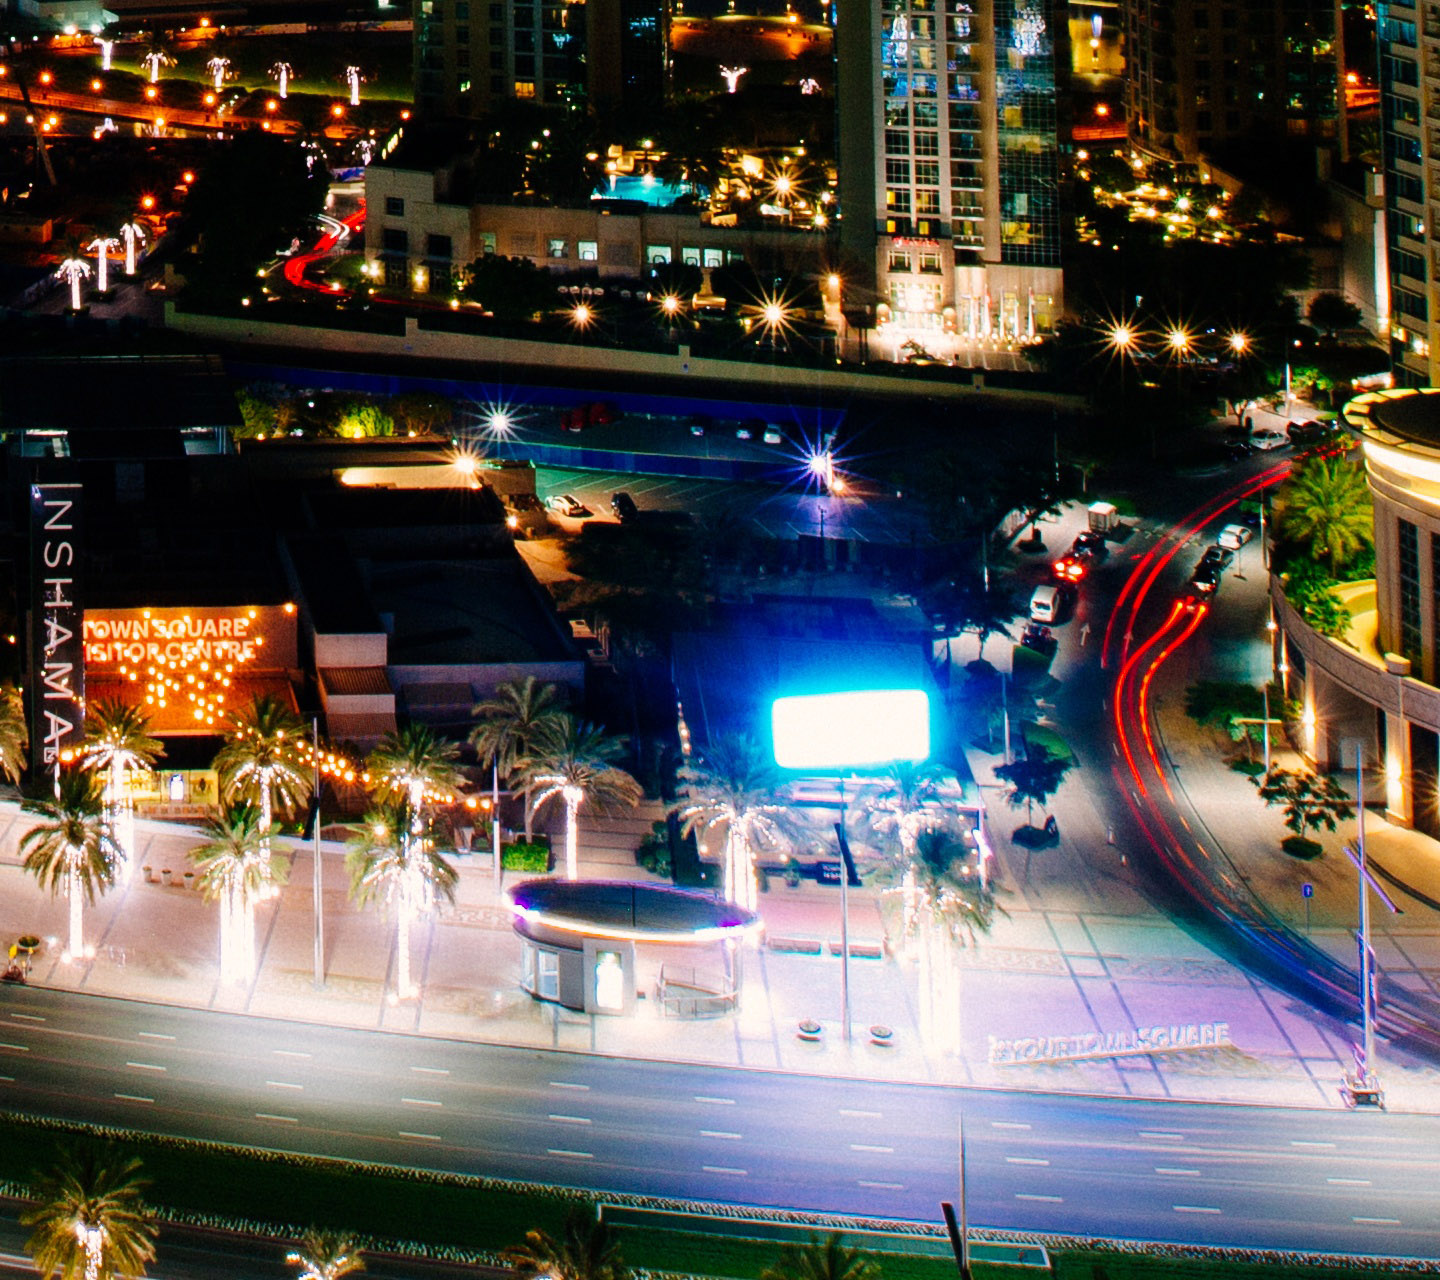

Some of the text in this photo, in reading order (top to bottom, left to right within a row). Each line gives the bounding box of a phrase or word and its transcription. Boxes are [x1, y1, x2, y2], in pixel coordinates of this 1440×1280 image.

[82, 618, 248, 640] TOWN SQUARE
[85, 640, 257, 662] ISITOR CENTRE
